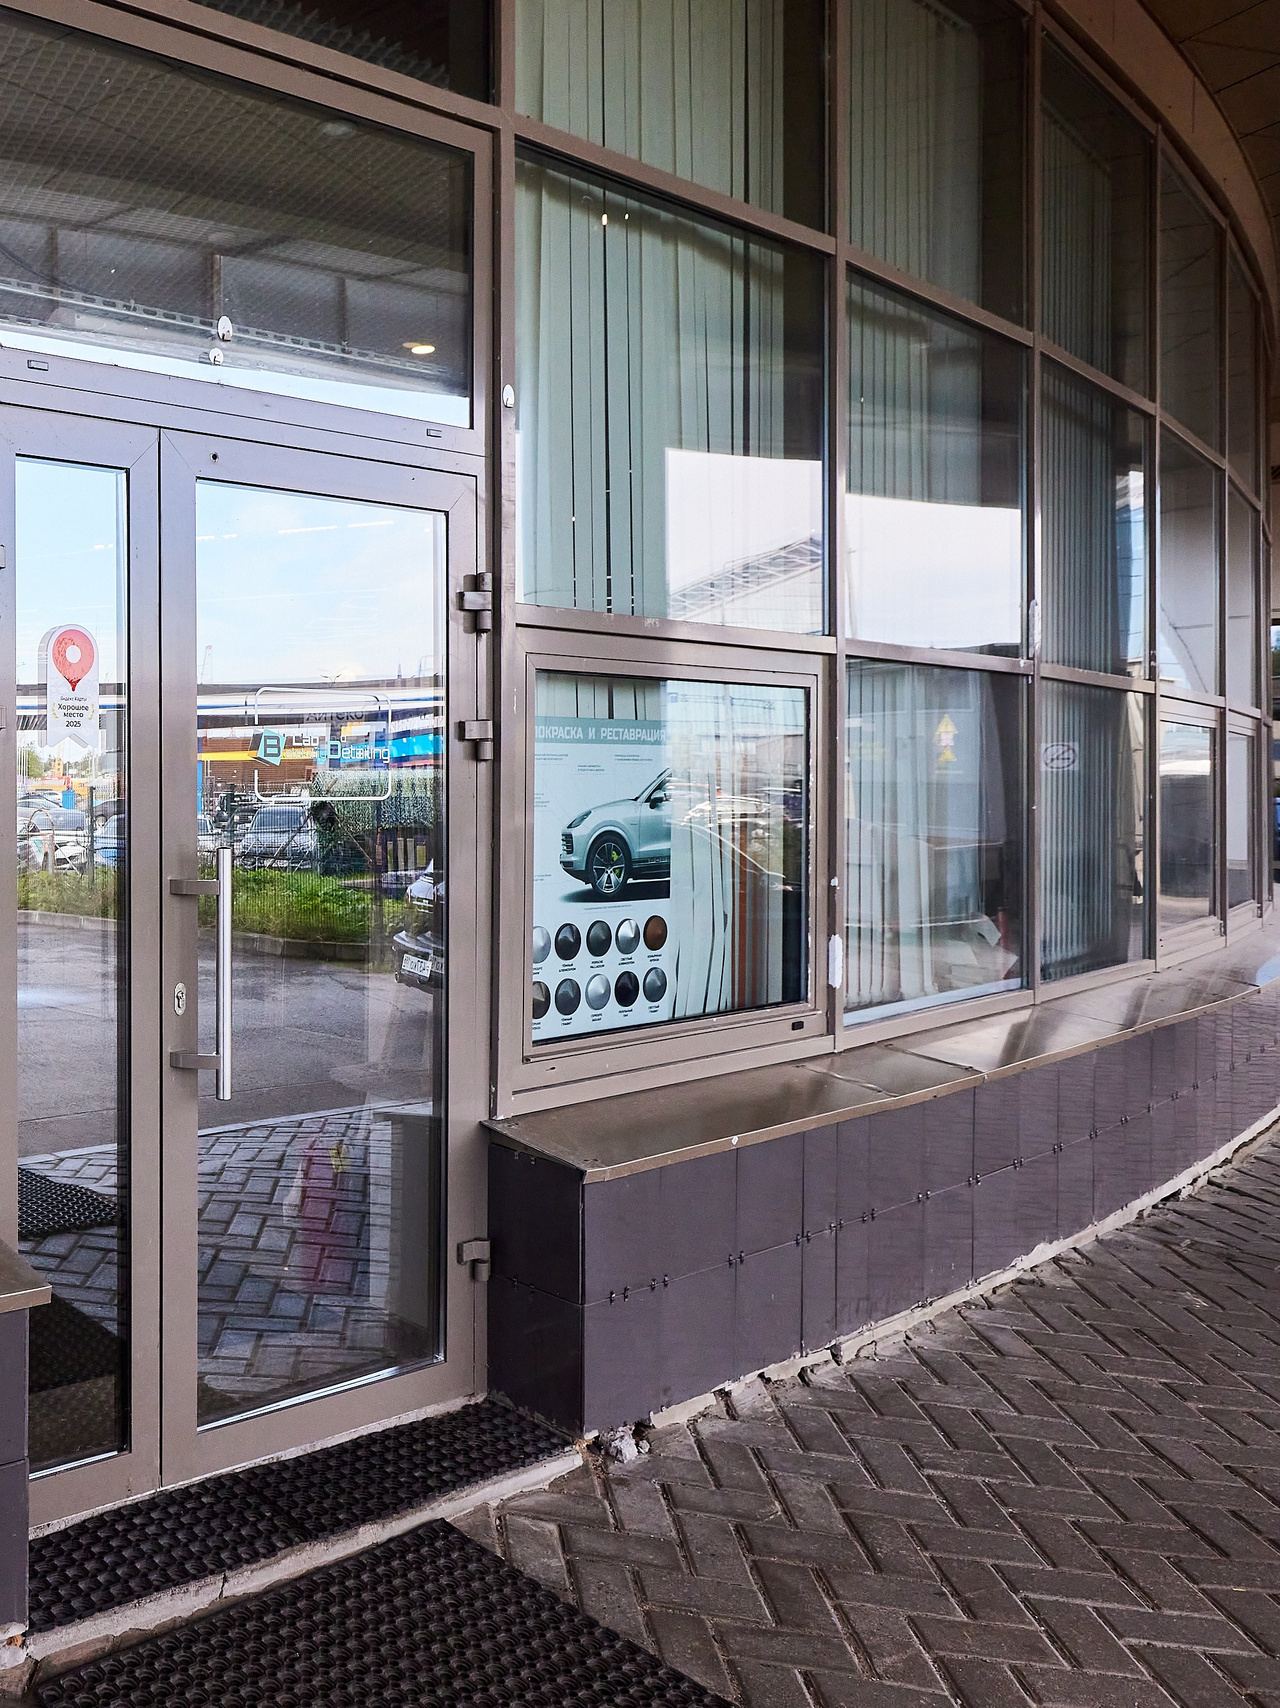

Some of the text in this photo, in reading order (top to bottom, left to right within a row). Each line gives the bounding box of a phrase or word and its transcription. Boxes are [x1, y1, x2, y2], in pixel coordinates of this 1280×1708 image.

[58, 703, 89, 711] Хорошее
[588, 727, 596, 740] И
[600, 727, 666, 743] РЕСТАВРАЦИЯ
[328, 740, 391, 764] Detailing
